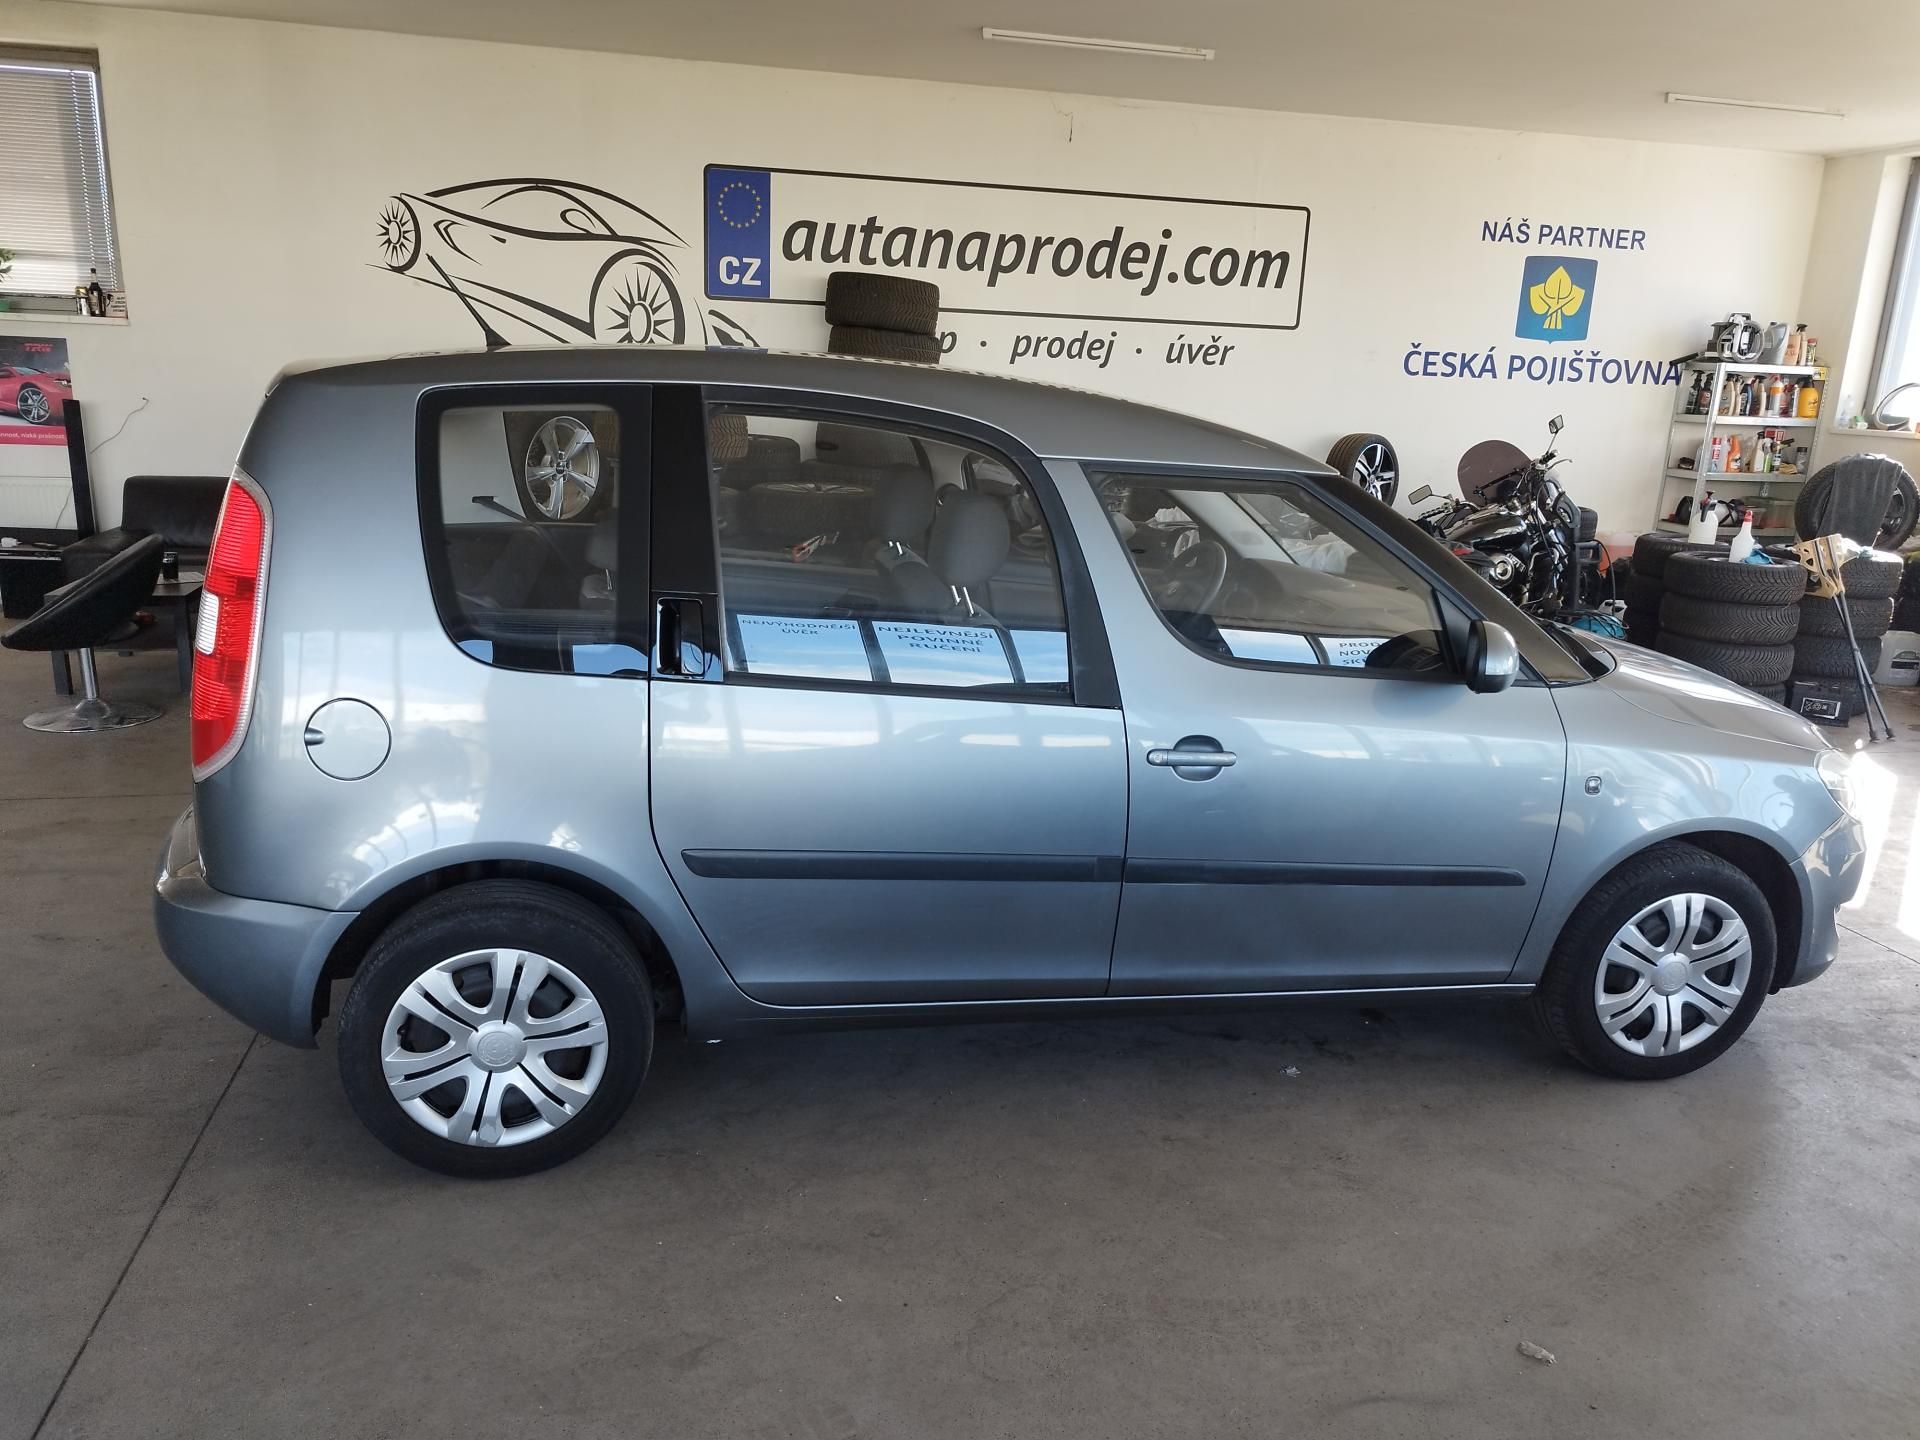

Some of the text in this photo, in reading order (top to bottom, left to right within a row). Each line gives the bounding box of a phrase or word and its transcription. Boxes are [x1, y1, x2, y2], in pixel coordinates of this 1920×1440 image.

[1482, 217, 1646, 251] NÁŠ PARTNER
[718, 255, 762, 286] CZ
[782, 215, 1291, 297] autanaprodej.com
[1009, 330, 1118, 369] prodej
[1165, 334, 1235, 366] úvěr
[1403, 342, 1680, 386] ČESKÁ POJIŠŤOVNA
